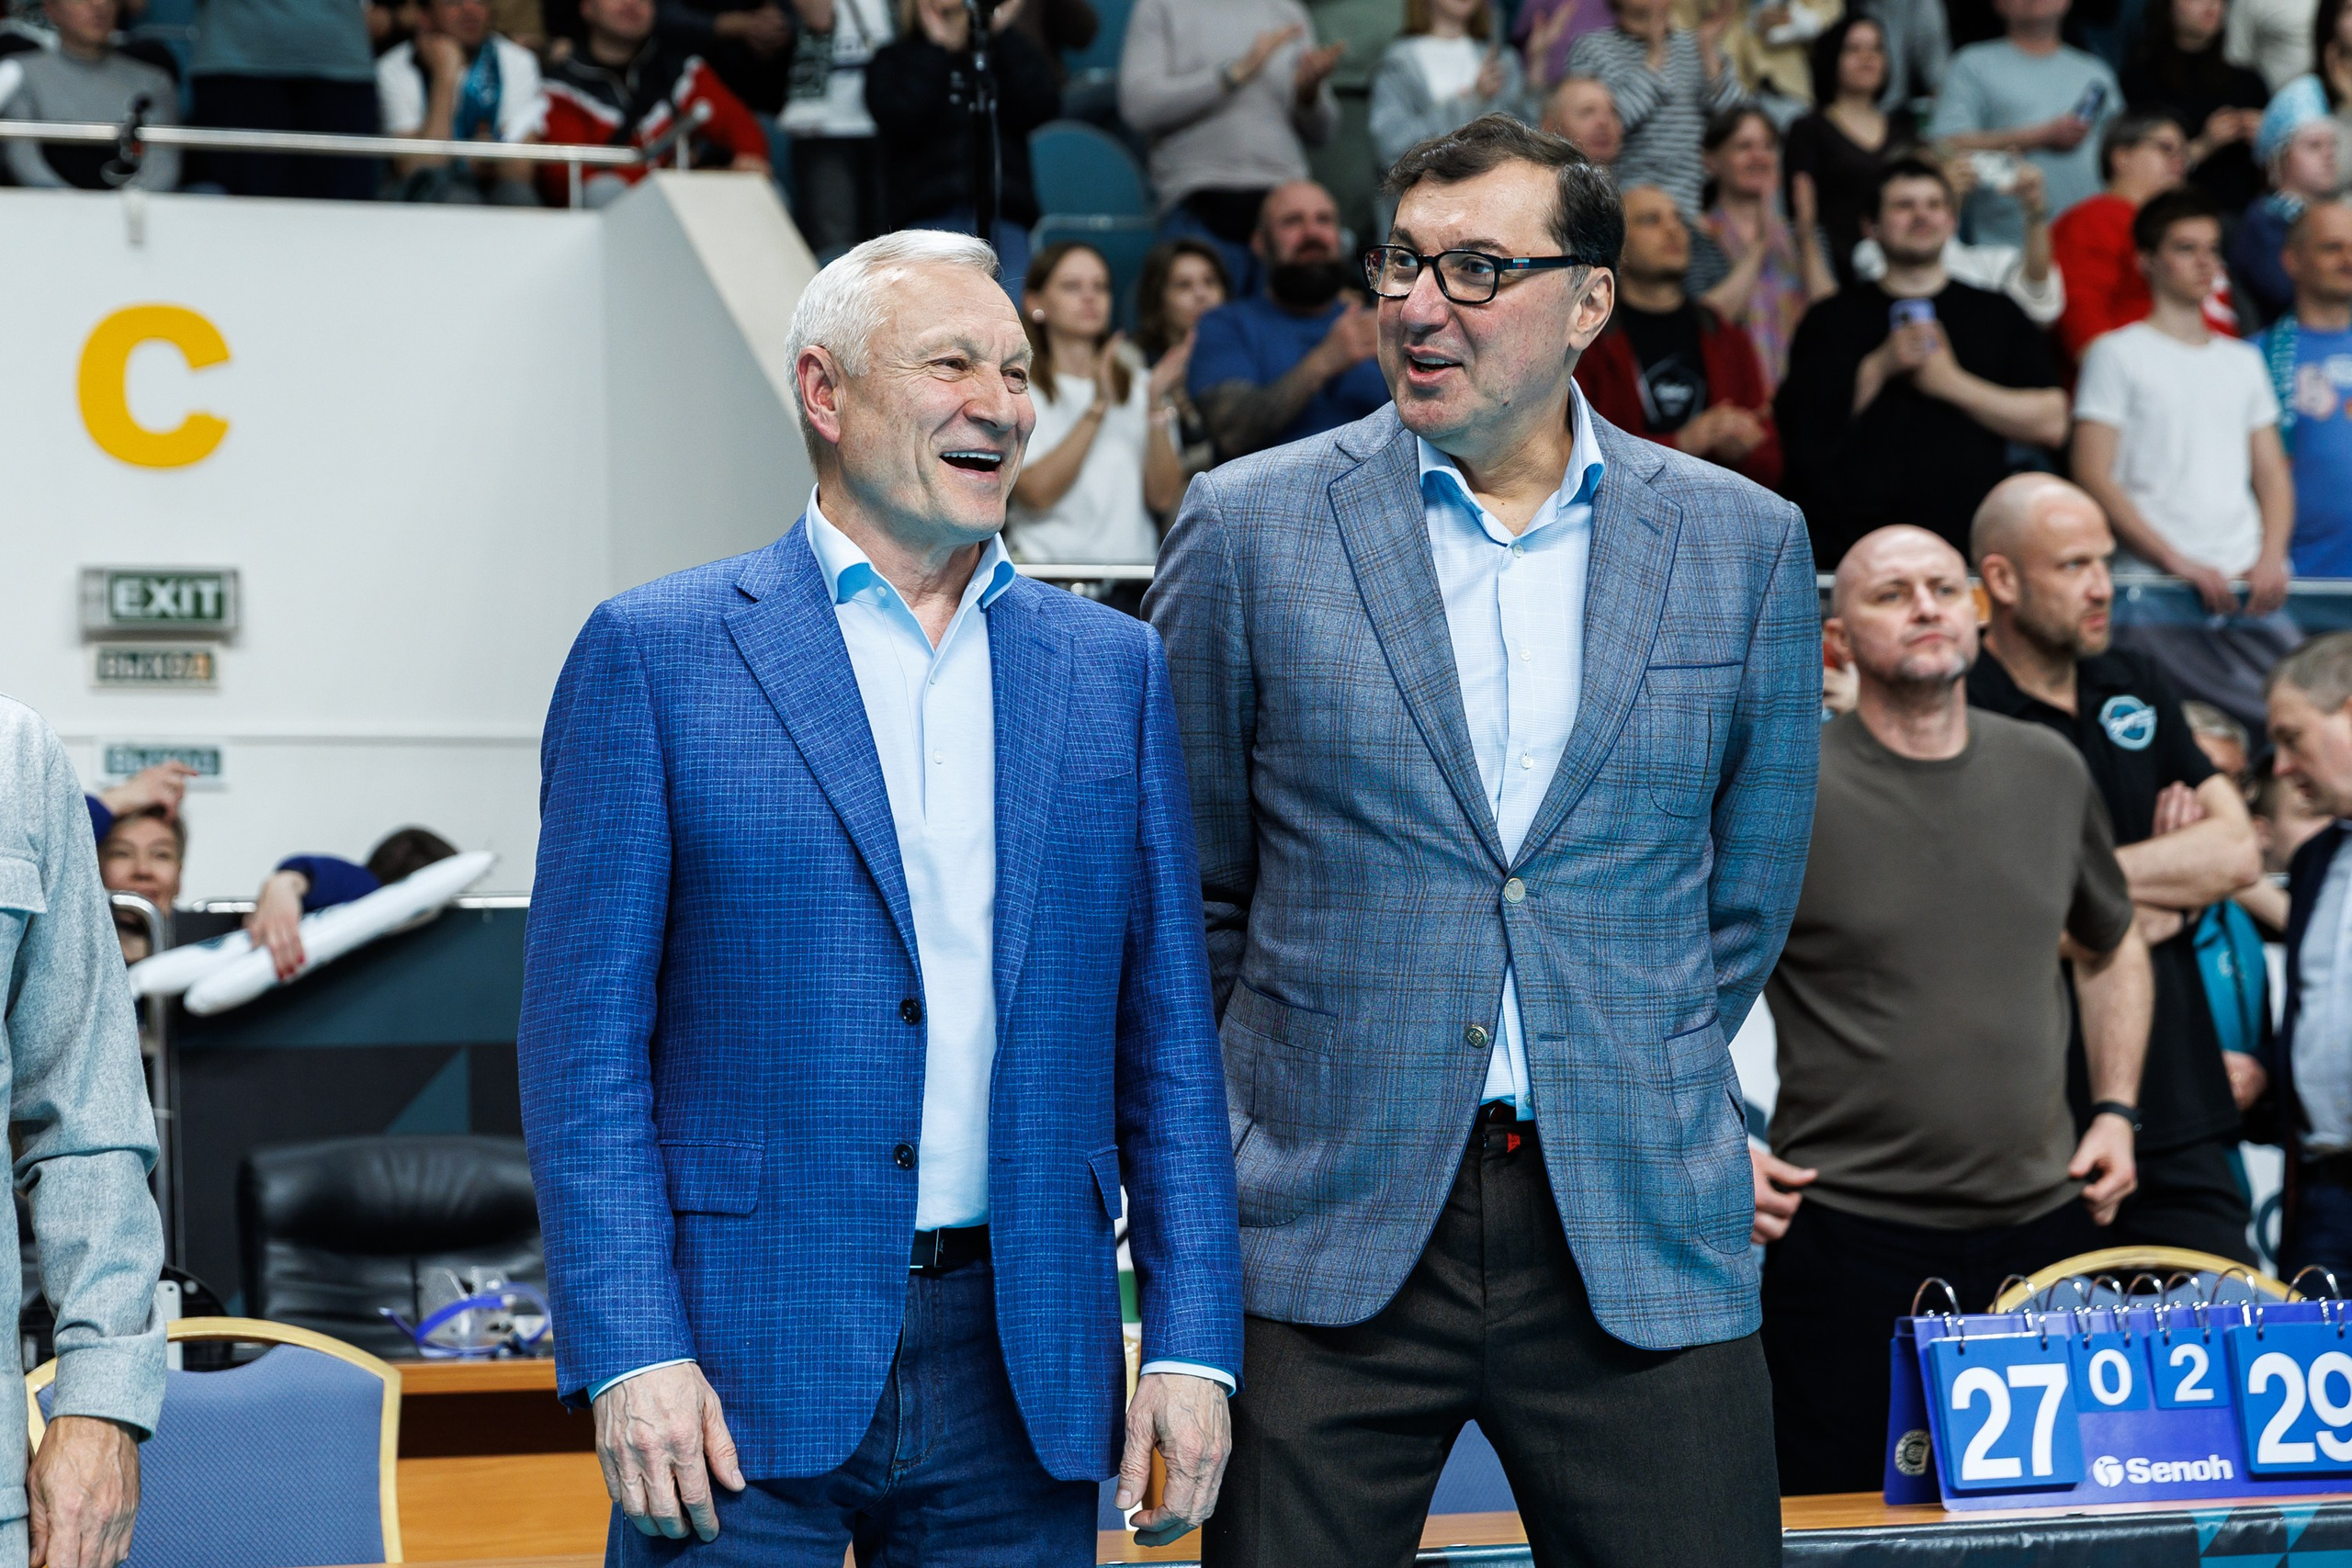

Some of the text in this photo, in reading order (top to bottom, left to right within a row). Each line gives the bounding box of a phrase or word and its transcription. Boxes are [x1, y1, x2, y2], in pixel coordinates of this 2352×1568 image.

[76, 303, 231, 468] C
[113, 580, 219, 616] EXIT
[1951, 1363, 2068, 1481] 27
[2088, 1348, 2132, 1405] 0
[2169, 1343, 2214, 1402] 2
[2248, 1351, 2352, 1464] 29
[2126, 1454, 2234, 1483] Senoh
